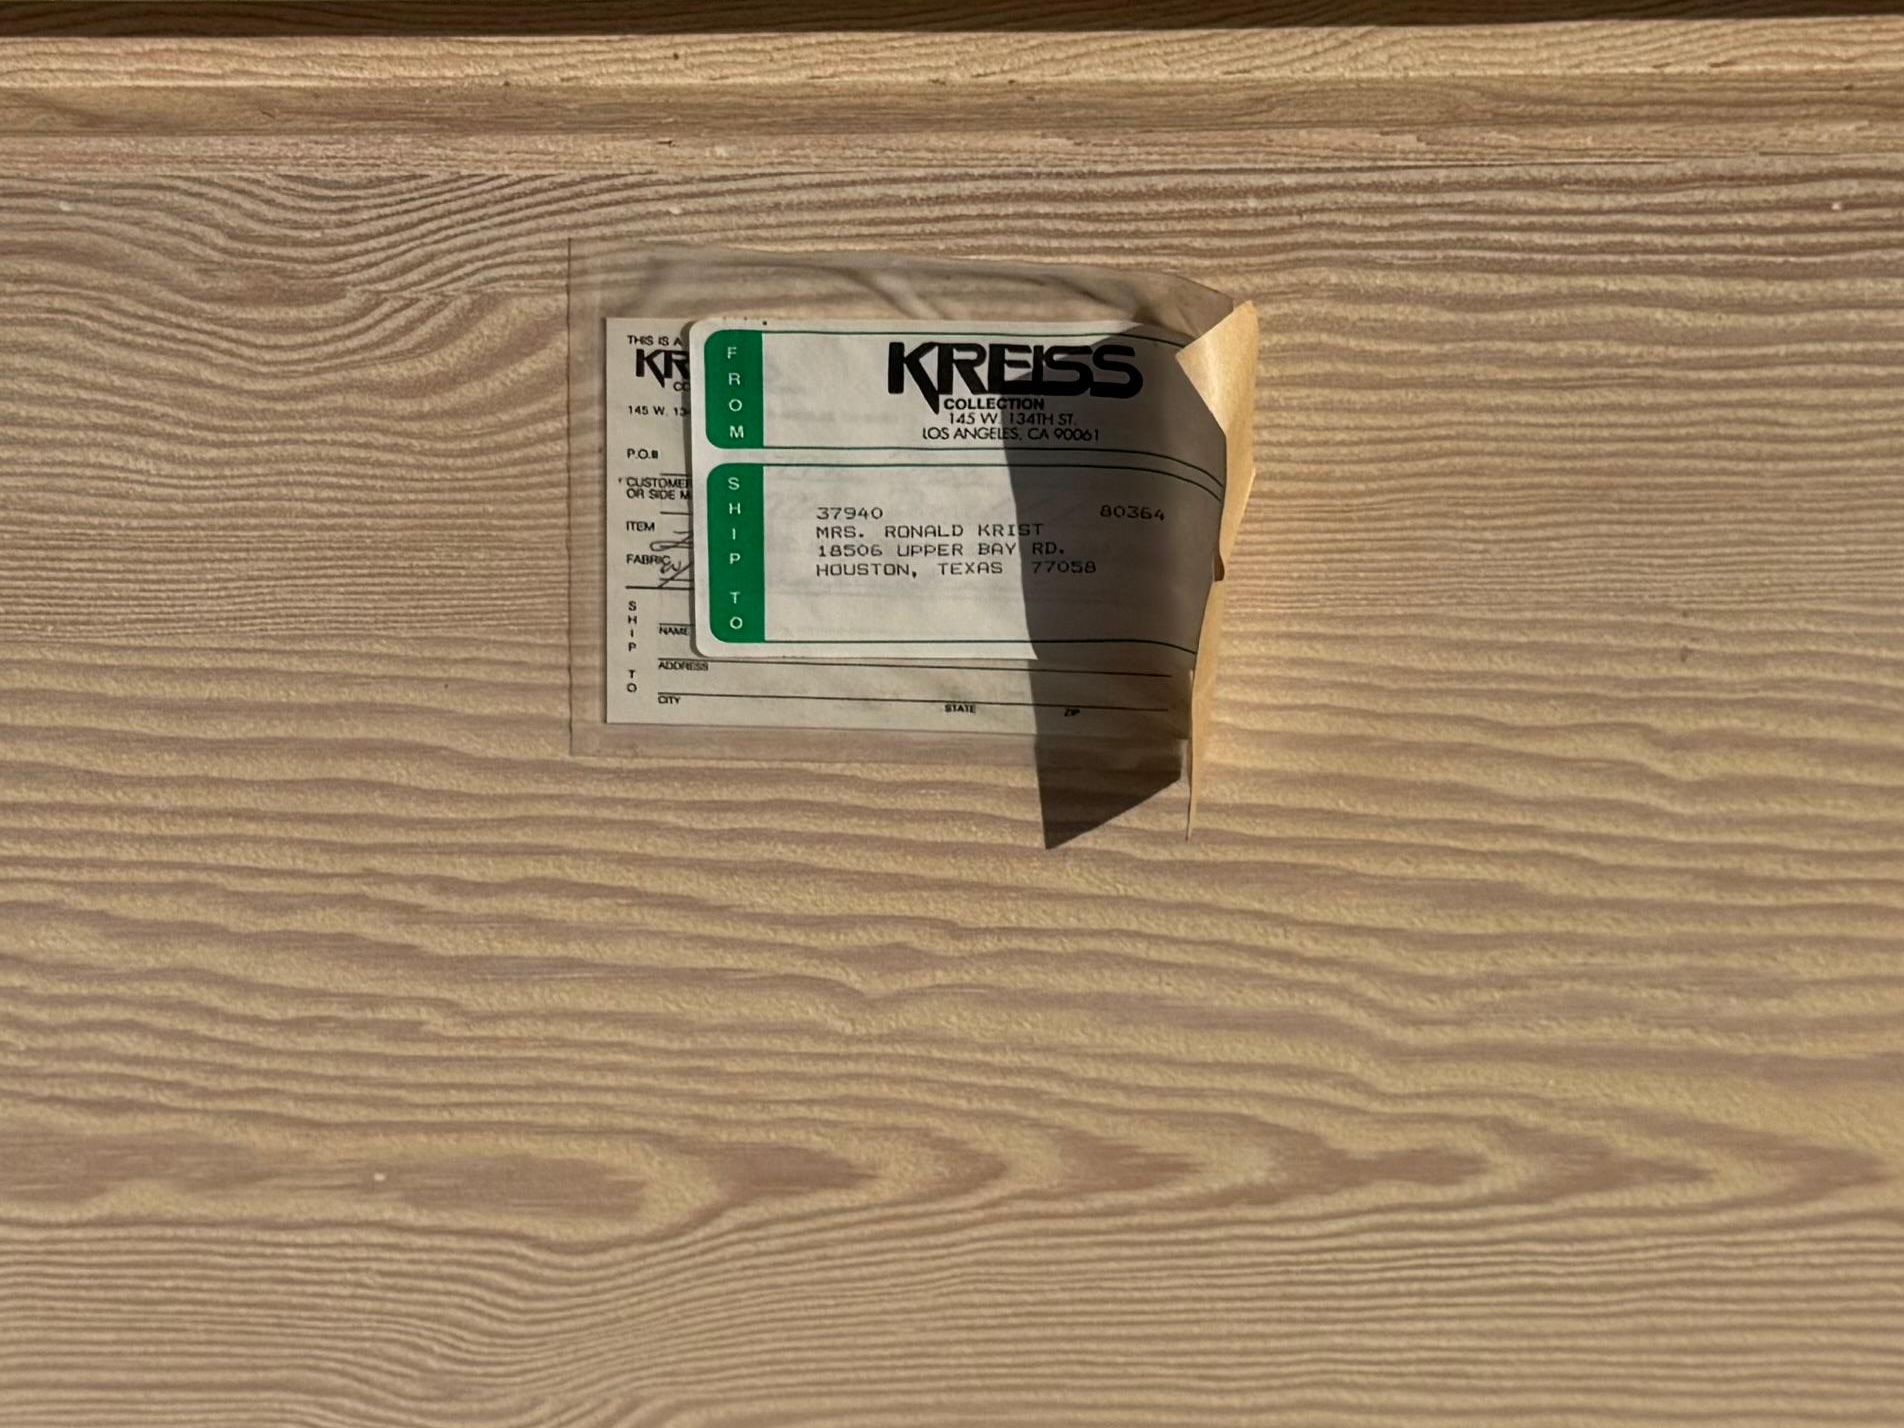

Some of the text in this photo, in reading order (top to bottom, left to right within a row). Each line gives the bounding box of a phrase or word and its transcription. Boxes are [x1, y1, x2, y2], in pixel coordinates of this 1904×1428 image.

[627, 335, 683, 346] THIS IS A
[887, 341, 1144, 415] KREISS
[727, 346, 744, 439] FROM
[628, 405, 649, 415] 145
[944, 398, 1044, 410] COLLECTION
[949, 413, 975, 425] 145
[1009, 413, 1053, 426] 134TH
[923, 427, 950, 440] LOS
[1027, 427, 1049, 440] CA
[1055, 428, 1099, 442] 90061
[626, 489, 645, 499] OR
[649, 490, 675, 500] SIDE
[816, 504, 1165, 521] 37940 80364
[626, 521, 655, 532] ITEM
[816, 523, 1045, 539] MRS. RONALD KRIST
[728, 477, 743, 630] SHIP TO
[819, 541, 1064, 557] 18506 UPPER BAY RD.
[626, 554, 671, 565] FABRIC
[816, 560, 1096, 579] HOUSTON, TEXAS 77058
[659, 627, 689, 636] NAME
[658, 661, 709, 671] ADDRESS
[658, 696, 680, 705] CITY
[945, 704, 976, 714] STATE
